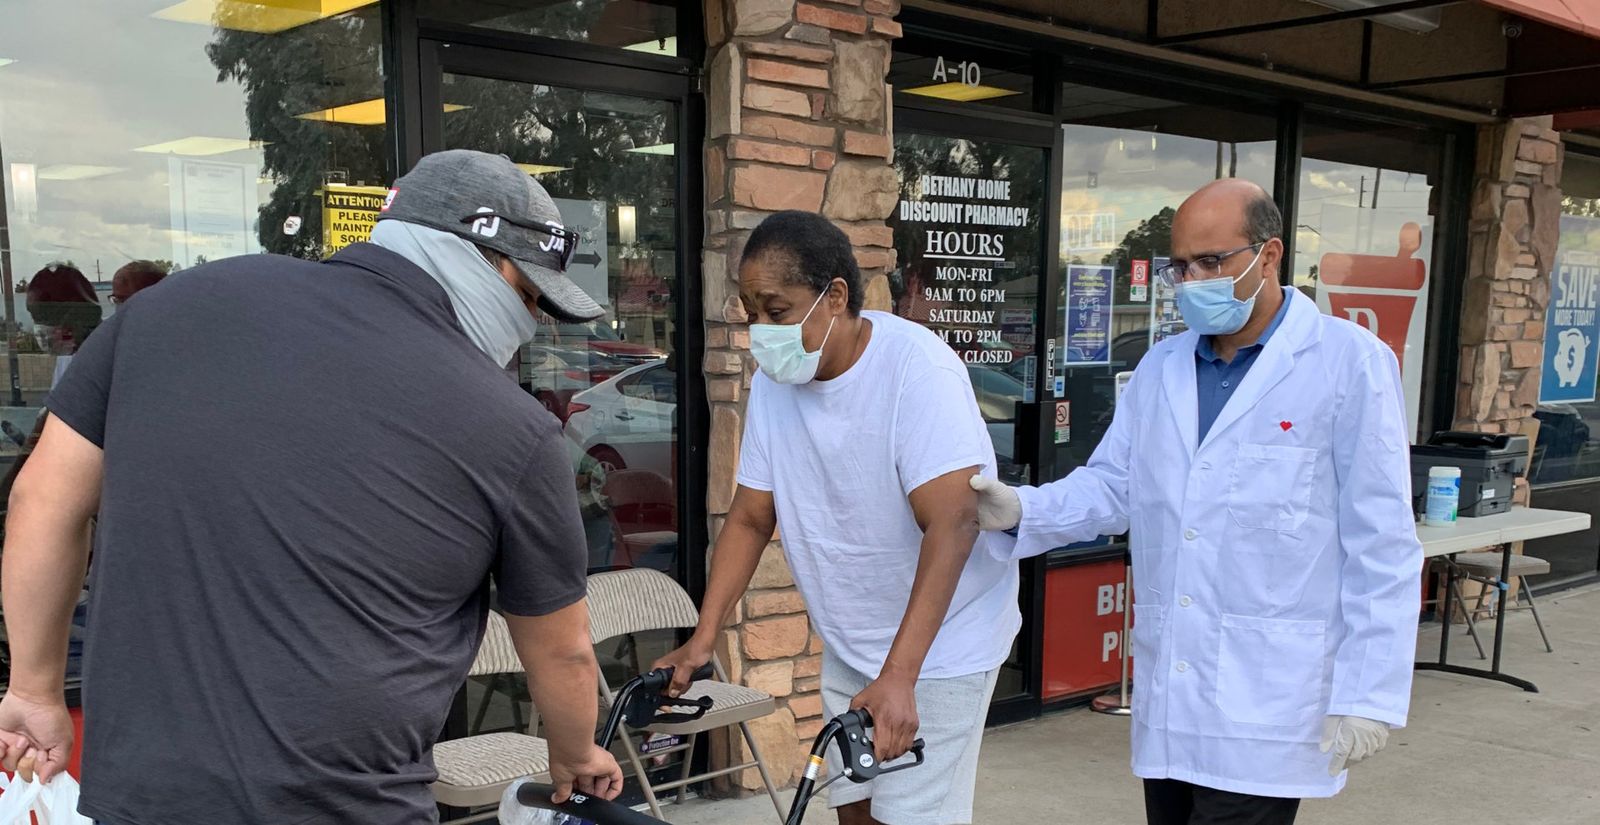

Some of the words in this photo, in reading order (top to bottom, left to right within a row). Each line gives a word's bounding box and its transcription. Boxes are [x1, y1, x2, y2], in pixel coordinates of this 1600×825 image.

[932, 55, 981, 88] A-10
[921, 175, 976, 198] BETHANY
[977, 179, 1011, 200] HOME
[900, 200, 963, 223] DISCOUNT
[964, 204, 1029, 227] PHARMACY
[925, 230, 1004, 256] HOURS
[935, 266, 993, 282] MON-FRI
[925, 287, 953, 301] 9AM
[957, 288, 976, 302] TO
[980, 289, 1006, 302] 6PM
[1556, 265, 1600, 308] SAVE
[929, 309, 995, 324] SATURDAY
[1554, 309, 1573, 326] MORE
[1573, 309, 1596, 327] TODAY!
[954, 330, 973, 343] TO
[976, 329, 1002, 343] 2PM
[964, 350, 1013, 364] CLOSED
[1047, 343, 1055, 378] PULL
